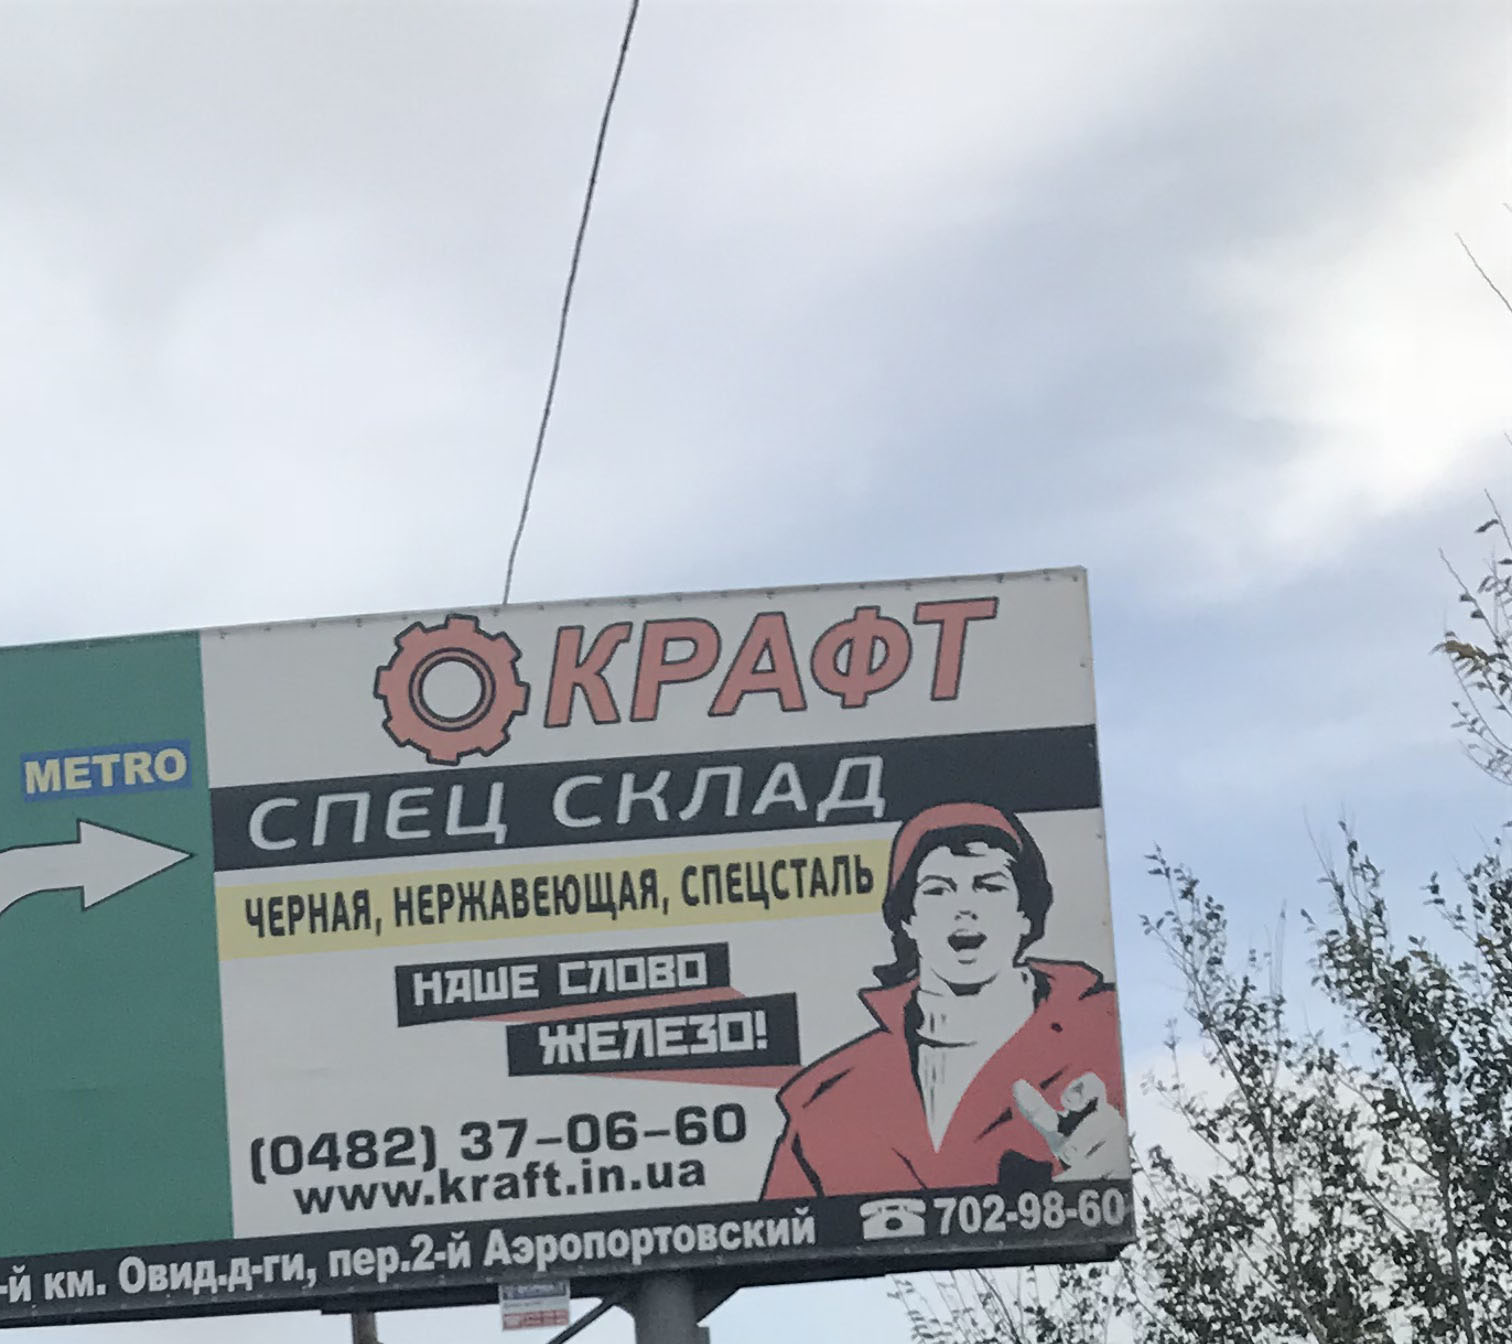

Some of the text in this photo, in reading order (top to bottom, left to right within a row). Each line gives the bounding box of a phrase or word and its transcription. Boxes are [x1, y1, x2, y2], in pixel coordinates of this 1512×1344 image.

[543, 597, 999, 729] КРАФТ
[24, 748, 188, 796] METRO
[248, 755, 886, 852] СПЕЦ СКЛАД
[245, 854, 875, 938] ЧЕРНАЯ, НЕРЖАВЕЮЩАЯ, СПЕЦСТАЛЬ
[413, 951, 708, 1006] НАШЕ СЛОВО
[538, 1010, 768, 1066] ЖЕЛЕЗО!
[250, 1103, 746, 1184] (0482) 37-06-60
[294, 1158, 706, 1216] www.kraft.in.ua
[933, 1188, 1126, 1236] 702-98-60
[44, 1269, 107, 1301] км.
[329, 1230, 472, 1284] пер.2-й
[482, 1206, 816, 1273] Аэропортовский
